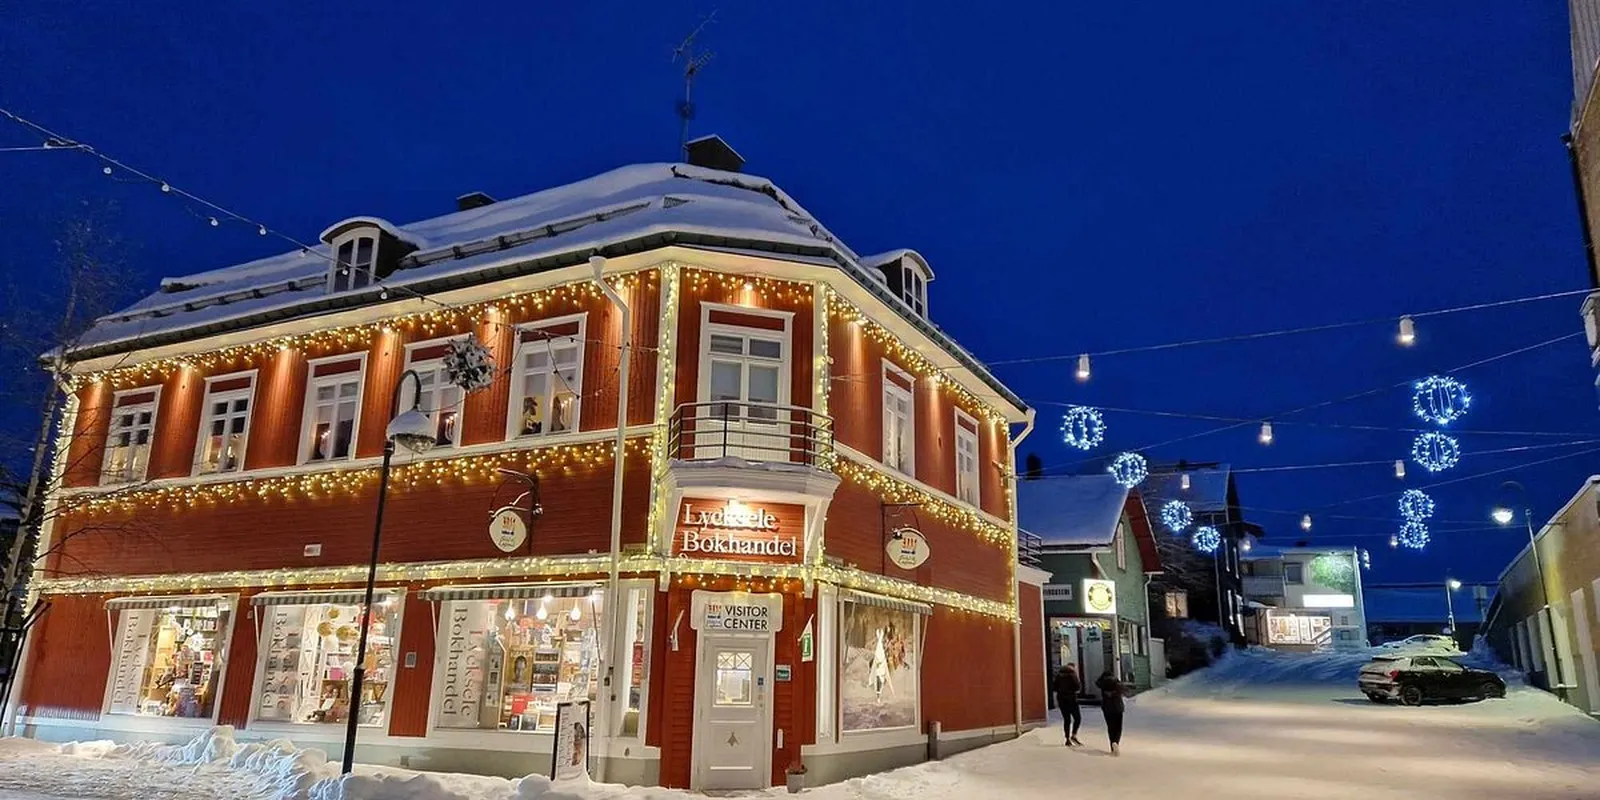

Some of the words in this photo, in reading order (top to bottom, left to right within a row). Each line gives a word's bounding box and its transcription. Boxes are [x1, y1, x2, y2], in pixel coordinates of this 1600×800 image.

[683, 530, 797, 556] Bokhandel
[684, 503, 776, 530] Lycksele
[724, 605, 768, 617] VISITOR
[724, 618, 768, 630] CENTER
[113, 616, 138, 703] Bokhandel
[262, 612, 287, 708] Bokhandel
[443, 607, 467, 715] Bokhandel
[460, 629, 483, 717] Lycksele
